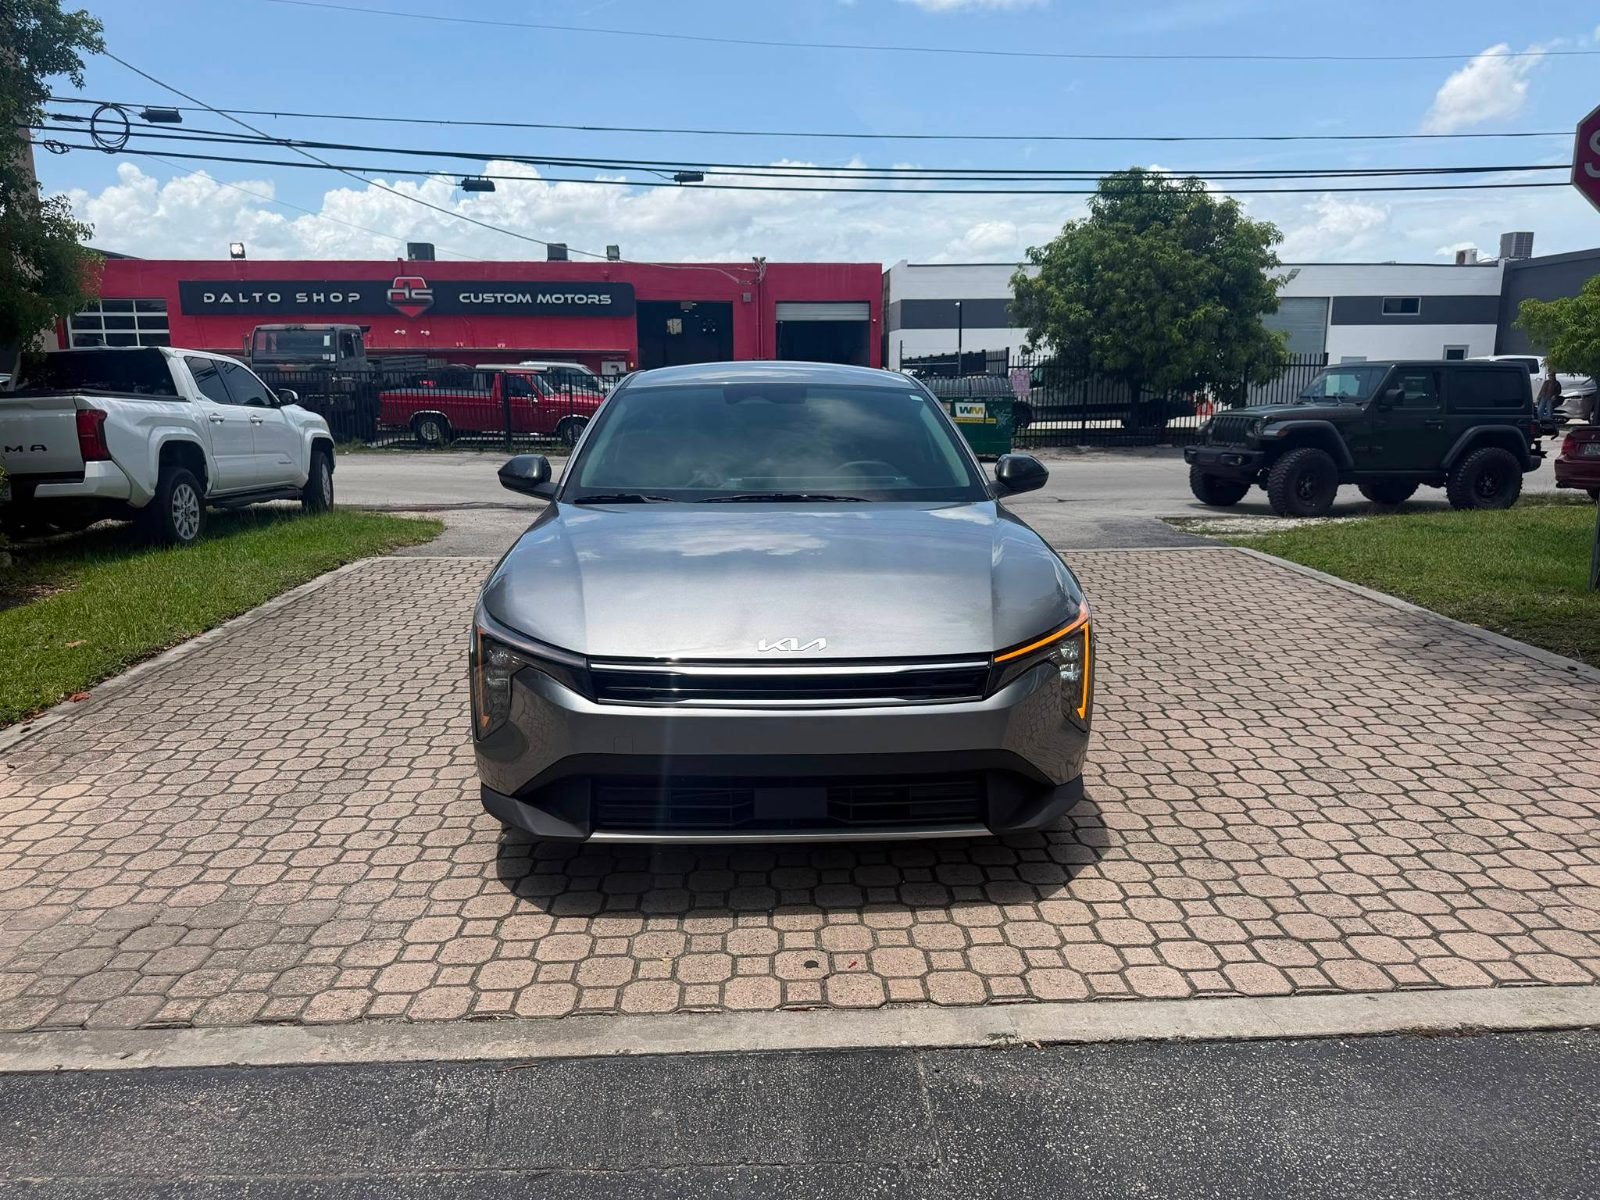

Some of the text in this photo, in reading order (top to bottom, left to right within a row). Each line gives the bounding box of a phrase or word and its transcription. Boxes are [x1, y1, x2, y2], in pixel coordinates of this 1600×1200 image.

[203, 293, 361, 303] DALTO SHOP
[459, 293, 612, 305] CUSTOM MOTORS
[959, 406, 984, 415] WM
[758, 637, 827, 651] KIA
